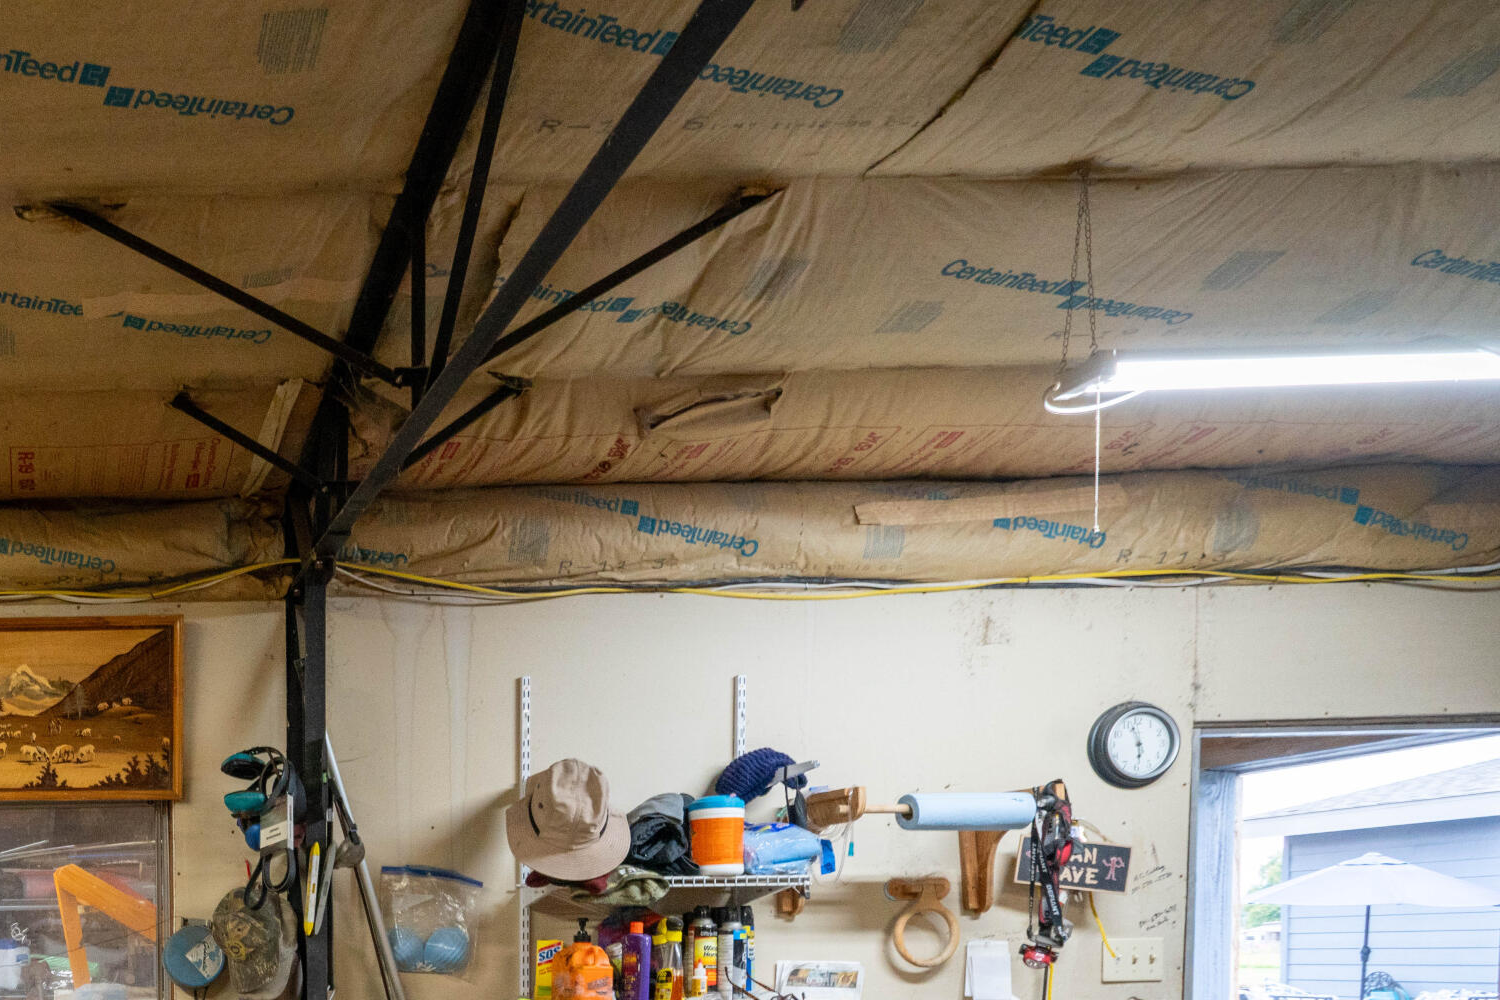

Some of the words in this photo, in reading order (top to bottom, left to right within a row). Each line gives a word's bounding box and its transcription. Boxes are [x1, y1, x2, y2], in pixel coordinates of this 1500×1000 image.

[1113, 58, 1255, 101] CertainTeed
[133, 88, 294, 126] CertainTeed
[941, 259, 1064, 296] CertainTeed
[147, 320, 271, 344] CertainTeed
[657, 518, 759, 558] CertainTeed
[10, 540, 117, 574] CertainTeed
[1058, 867, 1100, 886] AVE
[1046, 883, 1060, 917] DEFIANT
